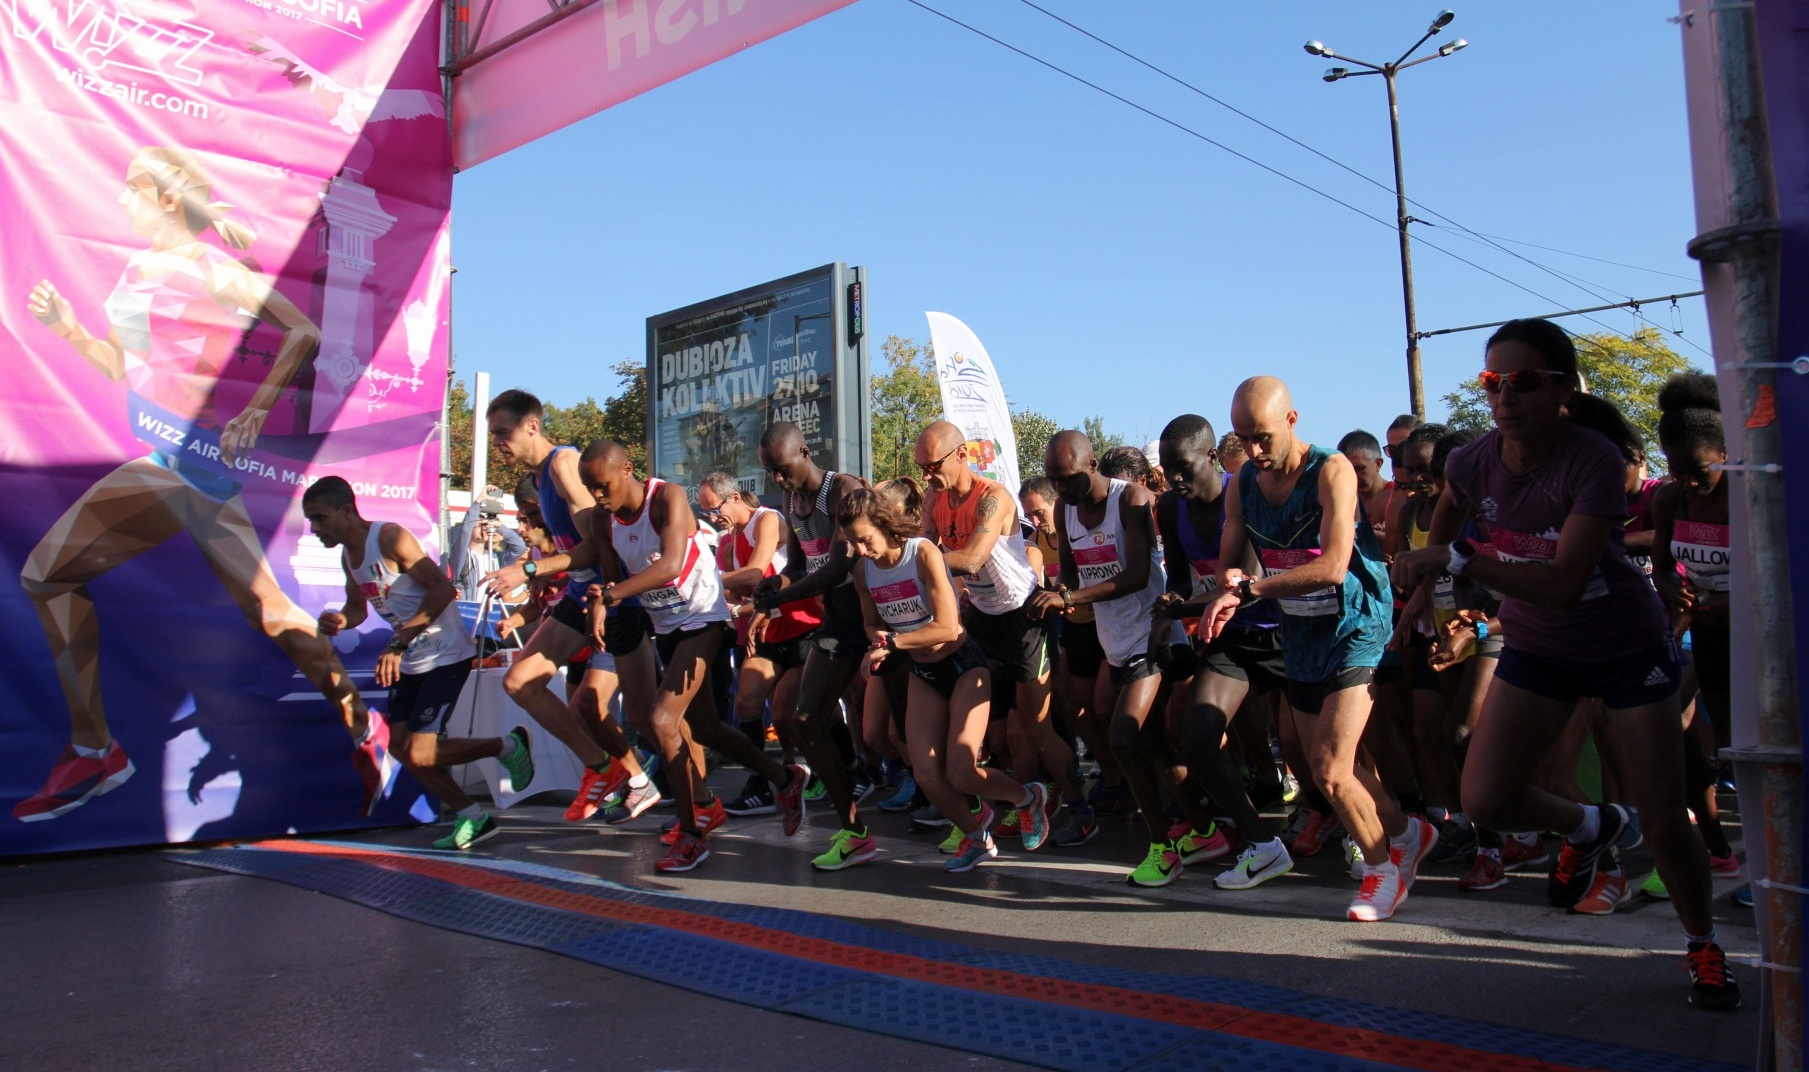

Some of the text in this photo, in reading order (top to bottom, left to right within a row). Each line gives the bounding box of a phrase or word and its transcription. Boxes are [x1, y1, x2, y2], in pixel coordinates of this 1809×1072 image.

[275, 4, 302, 20] 2017
[56, 67, 209, 120] wizzair.com
[662, 333, 754, 385] DUBIOZA
[772, 350, 818, 376] FRIDAY
[773, 400, 820, 424] ARENA
[795, 417, 821, 435] EEC
[137, 411, 187, 447] WIZZ
[187, 439, 221, 462] AIR
[234, 455, 277, 481] OFIA
[380, 484, 416, 500] 2017
[1078, 563, 1120, 580] KIPRONO
[1643, 676, 1670, 687] adidas
